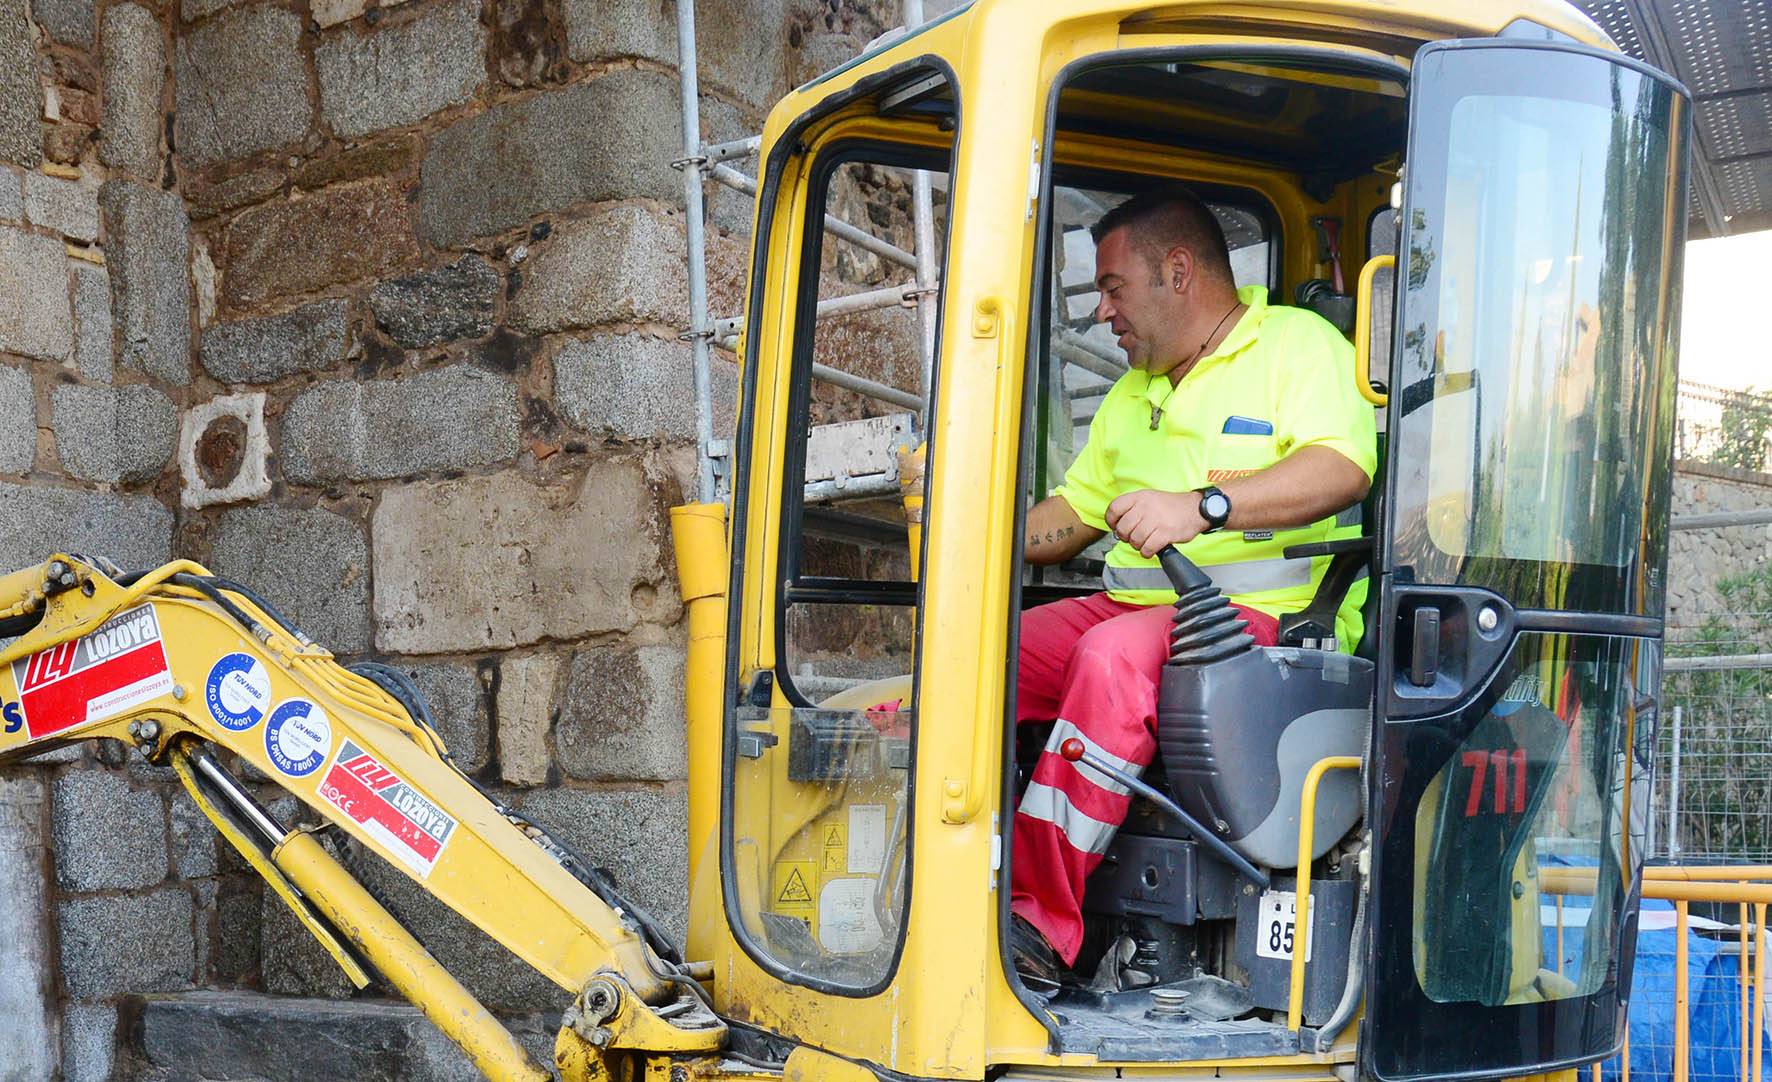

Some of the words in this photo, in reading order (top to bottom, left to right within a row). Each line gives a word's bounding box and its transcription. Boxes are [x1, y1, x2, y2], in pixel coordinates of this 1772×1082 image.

[209, 684, 217, 701] ISO
[245, 682, 262, 700] NORD
[212, 703, 252, 726] 9001/14001
[270, 729, 278, 742] BS
[304, 728, 322, 743] NORD
[271, 744, 292, 770] OHSAS
[293, 756, 316, 771] 18001
[1461, 749, 1527, 817] 711
